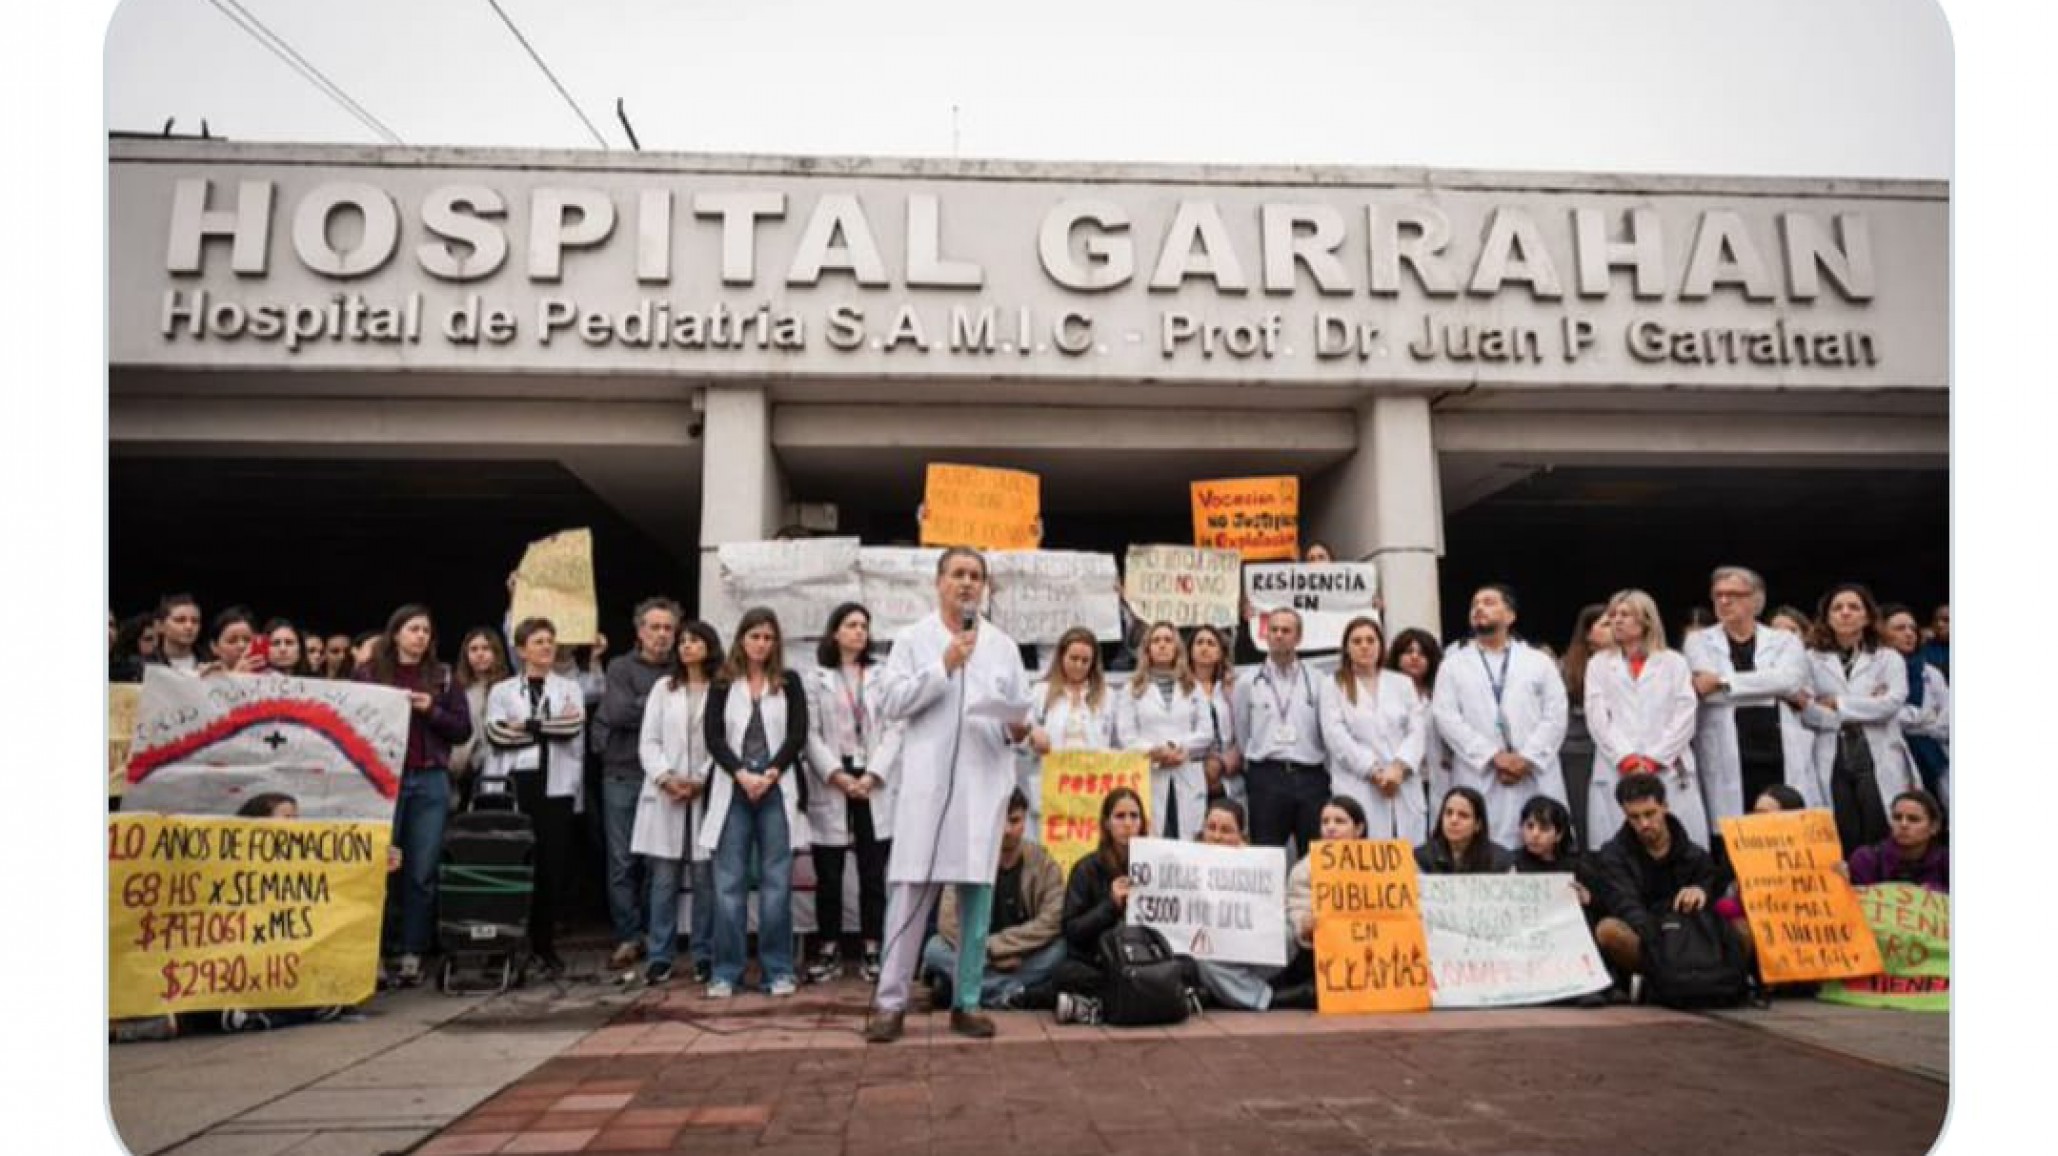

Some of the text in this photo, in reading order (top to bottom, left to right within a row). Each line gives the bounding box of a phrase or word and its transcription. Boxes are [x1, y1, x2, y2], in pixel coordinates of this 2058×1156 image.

[167, 178, 1876, 305] HOSPITAL GARRAHAN
[161, 290, 422, 353] Hospital
[443, 296, 517, 347] de
[537, 298, 805, 353] Pediatria
[826, 303, 1109, 355] S.A.M.I.C.
[1162, 311, 1294, 359] Prof.
[1408, 316, 1543, 366] Juan
[1626, 316, 1878, 368] Garrahan
[1175, 573, 1195, 596] NO
[1294, 595, 1320, 611] EN
[109, 823, 374, 863] 10 AÑOS DE FORMACIÓN
[1321, 843, 1402, 872] SALUD
[123, 872, 162, 908] 68
[168, 871, 203, 906] HS
[228, 869, 331, 906] SEMANA
[269, 905, 314, 940] MES
[1351, 921, 1379, 942] EN
[159, 953, 248, 1002] $2930
[266, 951, 301, 991] HS
